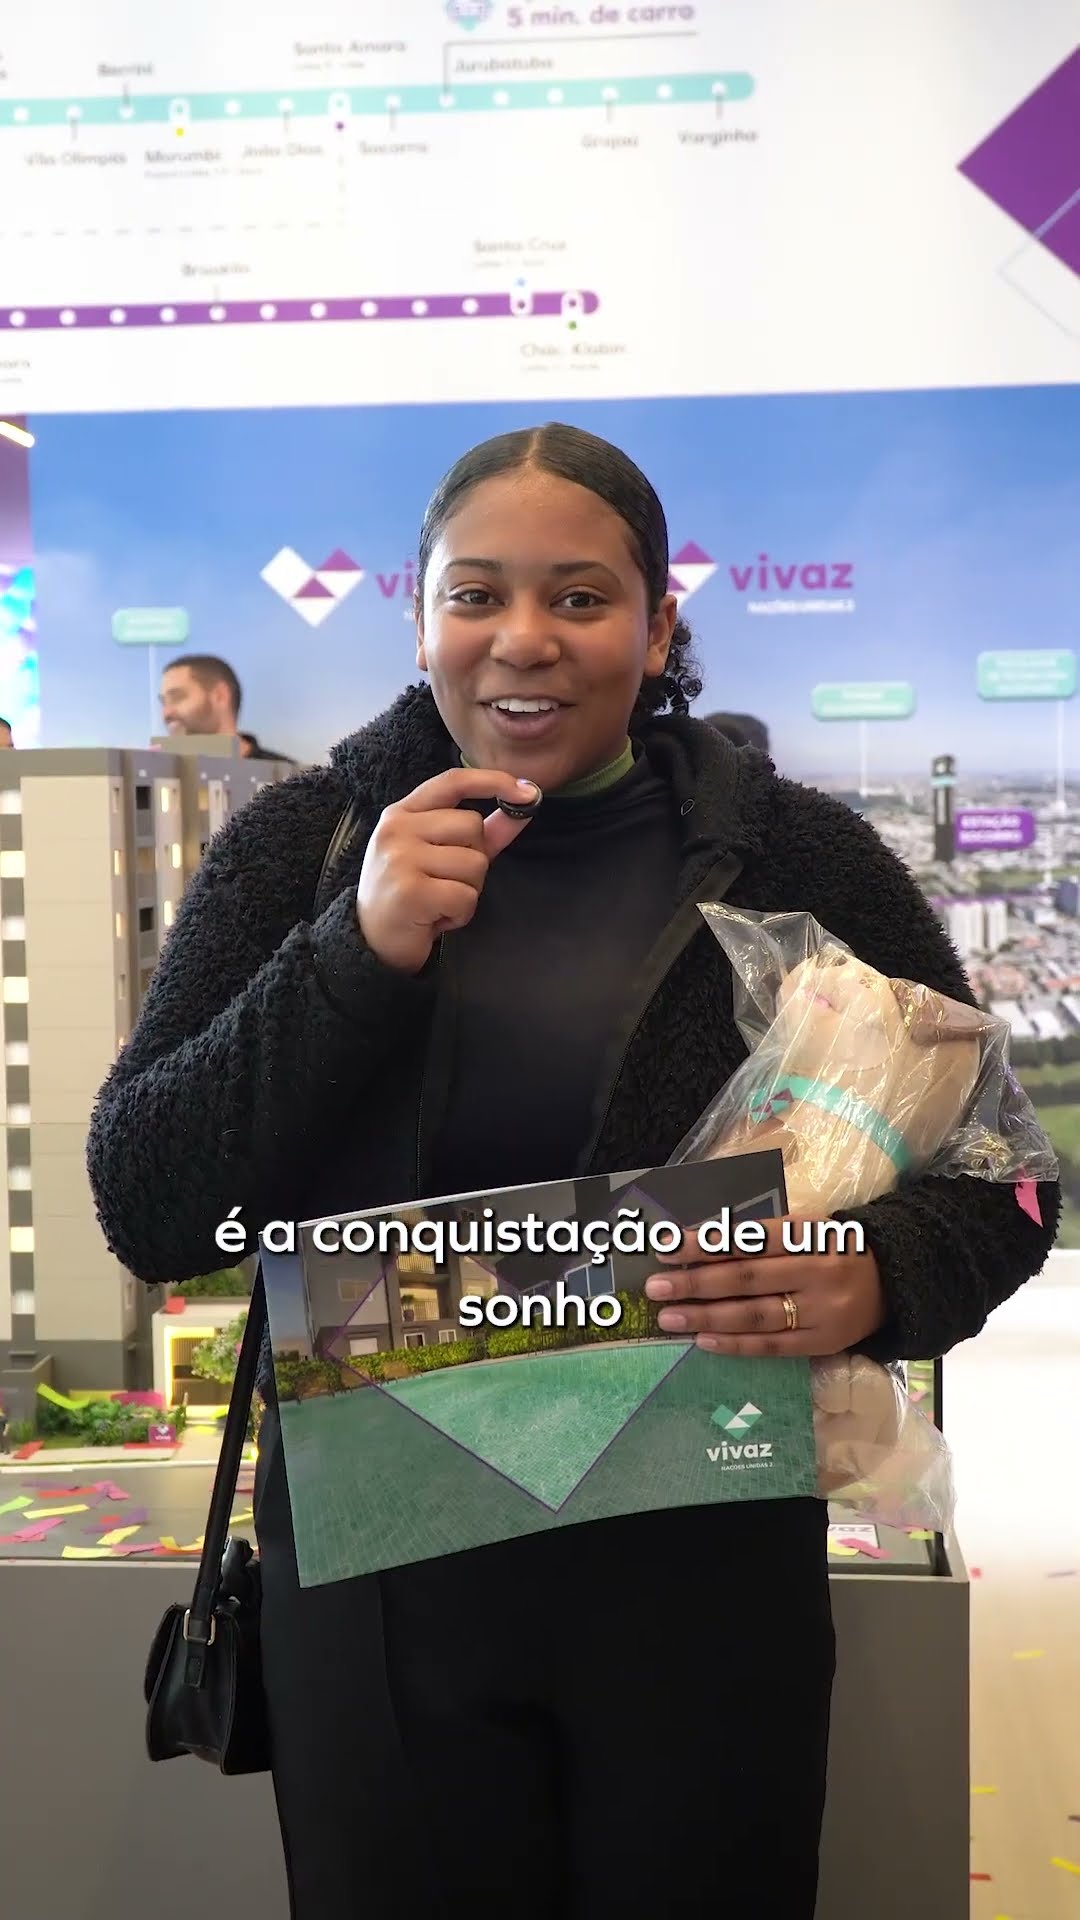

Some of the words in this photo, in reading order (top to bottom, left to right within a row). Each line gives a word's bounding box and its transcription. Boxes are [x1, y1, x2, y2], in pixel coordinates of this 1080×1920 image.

[507, 8, 523, 27] 5
[530, 8, 580, 26] min.
[589, 5, 620, 25] de
[626, 4, 696, 24] carro
[729, 553, 854, 592] vivaz
[706, 1441, 773, 1462] vivaz
